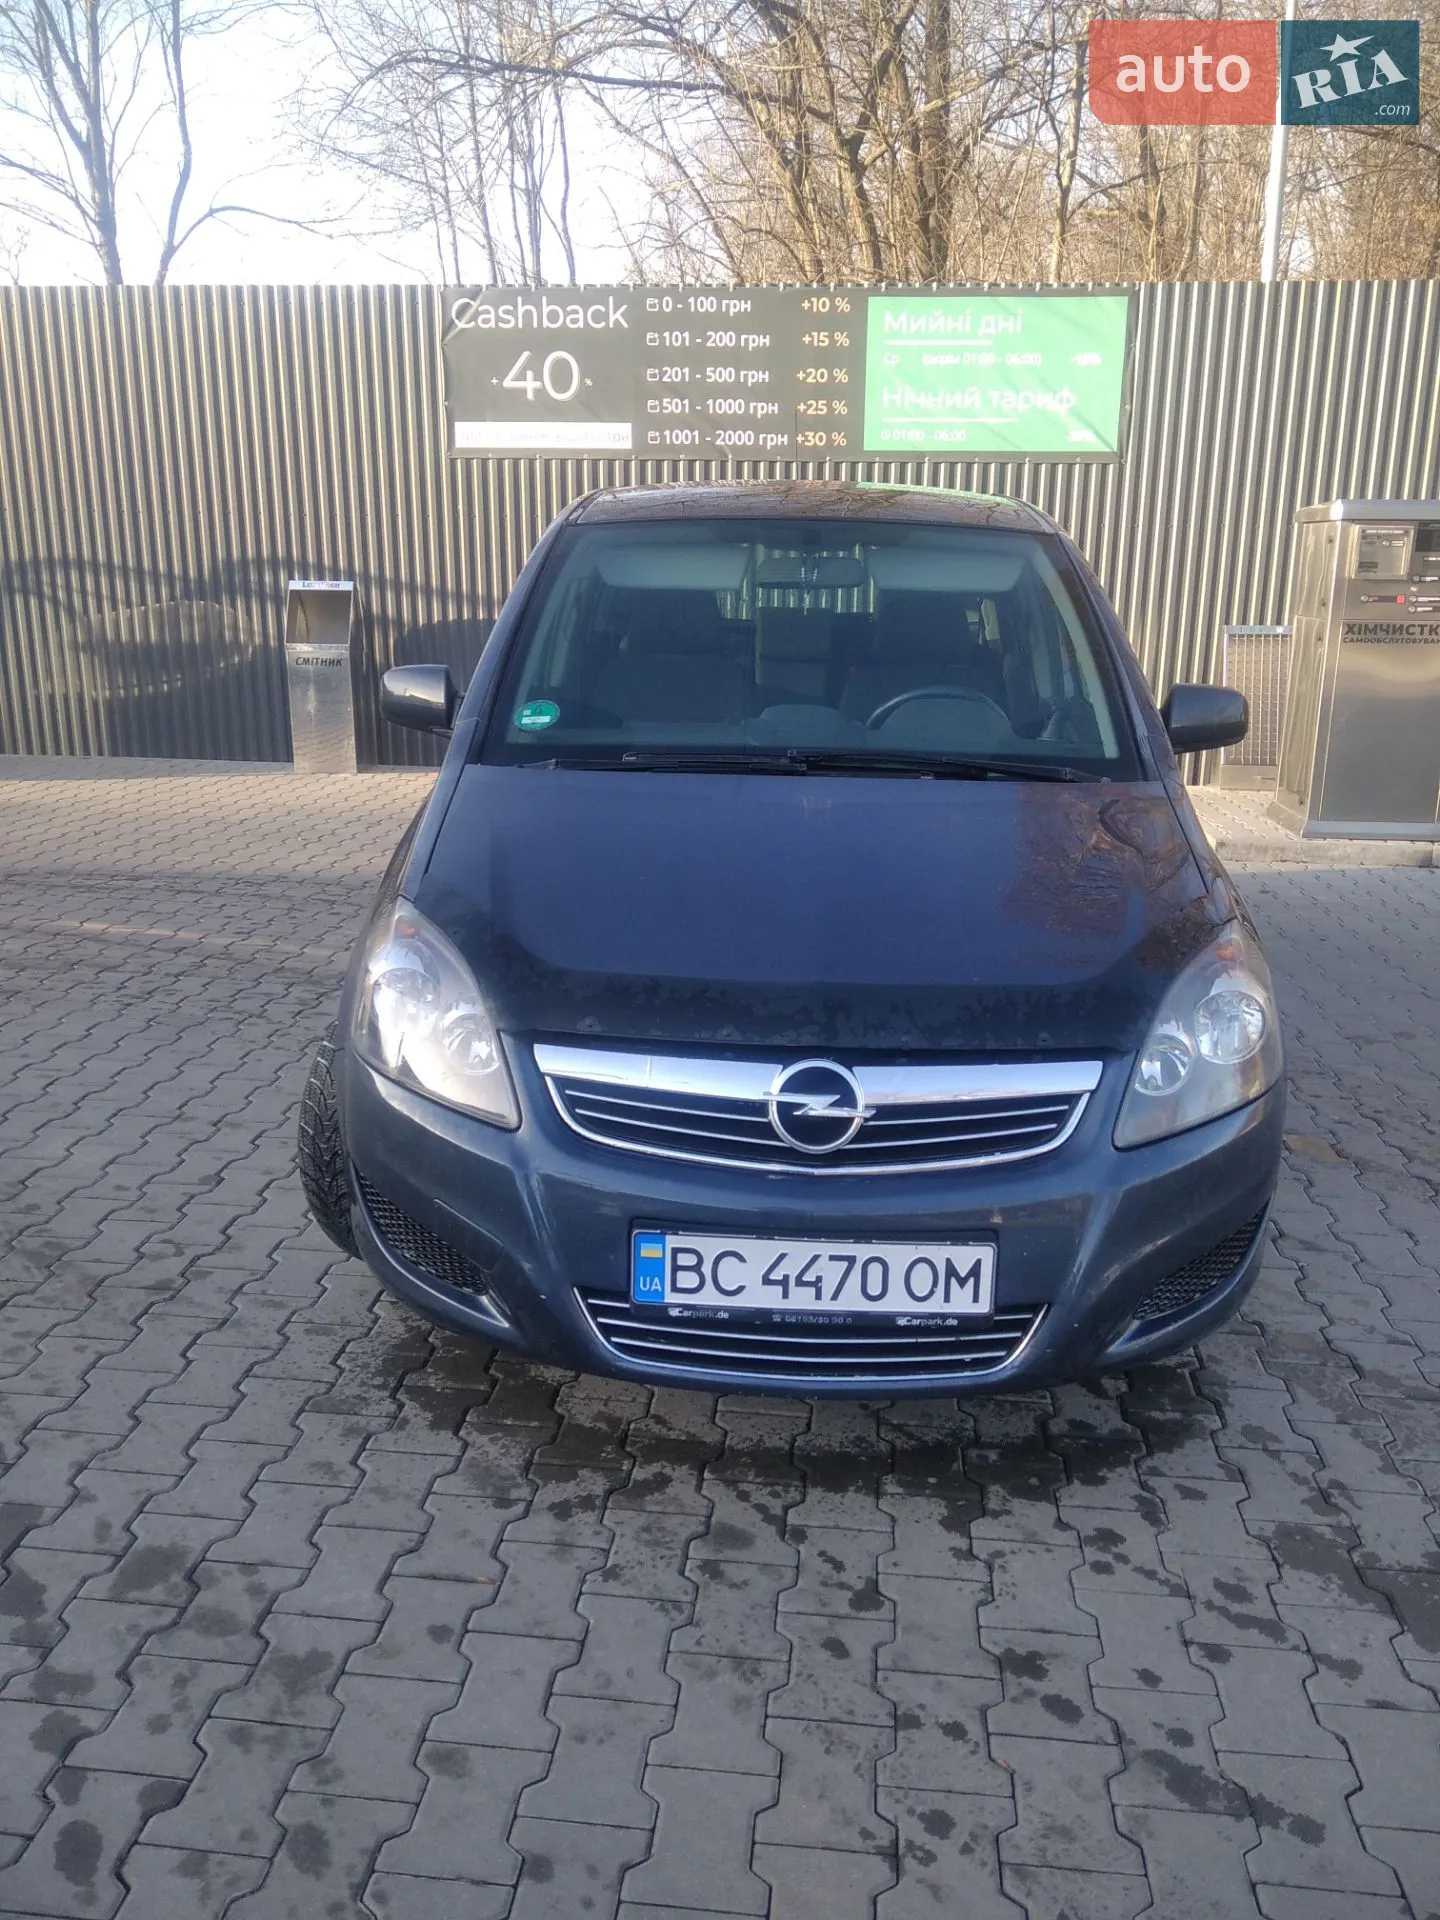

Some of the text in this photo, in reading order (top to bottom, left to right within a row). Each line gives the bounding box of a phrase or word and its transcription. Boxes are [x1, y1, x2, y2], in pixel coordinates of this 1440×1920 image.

[451, 296, 629, 329] Cashback
[662, 297, 673, 312] 0
[688, 297, 717, 312] 100
[722, 300, 751, 316] грн
[801, 297, 830, 313] +10
[835, 298, 851, 313] %
[883, 309, 1023, 336] Мийні дні
[662, 332, 690, 346] 101
[706, 332, 736, 347] 200
[741, 335, 770, 351] грн
[802, 332, 829, 347] +15
[834, 332, 850, 347] %
[662, 367, 690, 382] 201
[705, 367, 735, 382] 500
[740, 371, 769, 387] грн
[797, 368, 828, 383] +20
[833, 369, 848, 383] %
[881, 383, 1077, 414] Нічний тариф
[662, 399, 689, 414] 501
[706, 399, 745, 414] 1000
[750, 402, 779, 418] грн
[797, 400, 828, 415] +25
[832, 400, 848, 415] %
[663, 430, 700, 444] 1001
[716, 430, 754, 445] 2000
[759, 434, 788, 449] грн
[796, 432, 827, 446] +30
[831, 432, 847, 446] %
[295, 656, 343, 668] СМІТНИК
[639, 1275, 662, 1292] UA
[669, 1246, 984, 1304] BC 4470 OM
